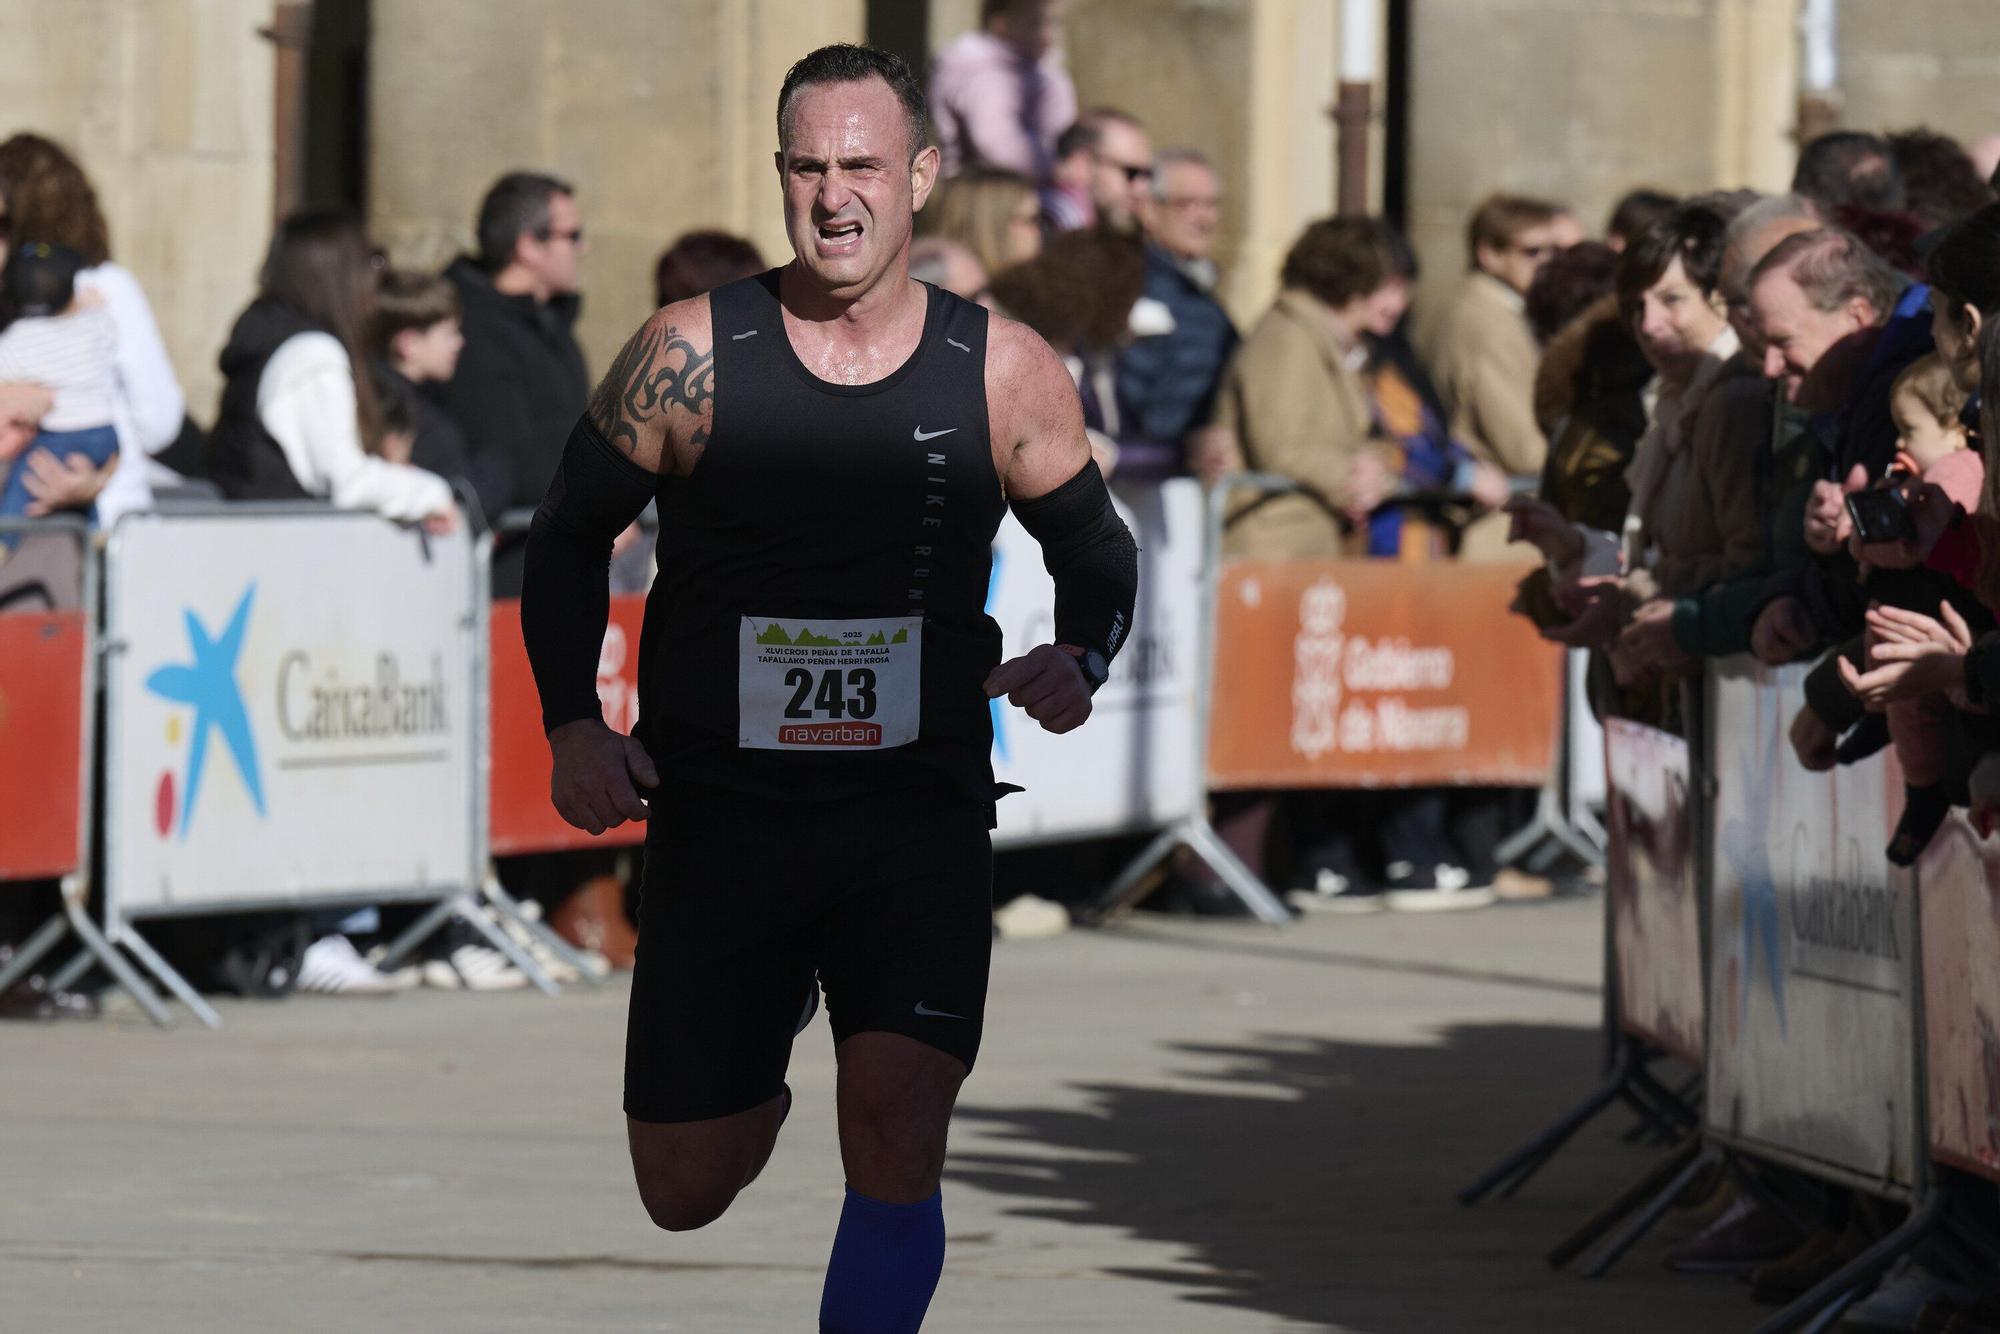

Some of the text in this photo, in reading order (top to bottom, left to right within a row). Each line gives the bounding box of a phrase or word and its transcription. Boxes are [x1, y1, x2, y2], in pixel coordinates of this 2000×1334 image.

[922, 453, 946, 528] NIKE
[842, 631, 863, 639] 2025
[765, 647, 783, 655] XLVI
[784, 648, 808, 656] CROSS
[811, 648, 838, 656] PEÑAS
[855, 647, 890, 656] TAFALLA
[757, 655, 890, 665] TAFALLAKO PEÑEN HERRI KROSA
[275, 650, 451, 742] CaixaBank
[784, 667, 877, 720] 243
[784, 726, 877, 742] navarban
